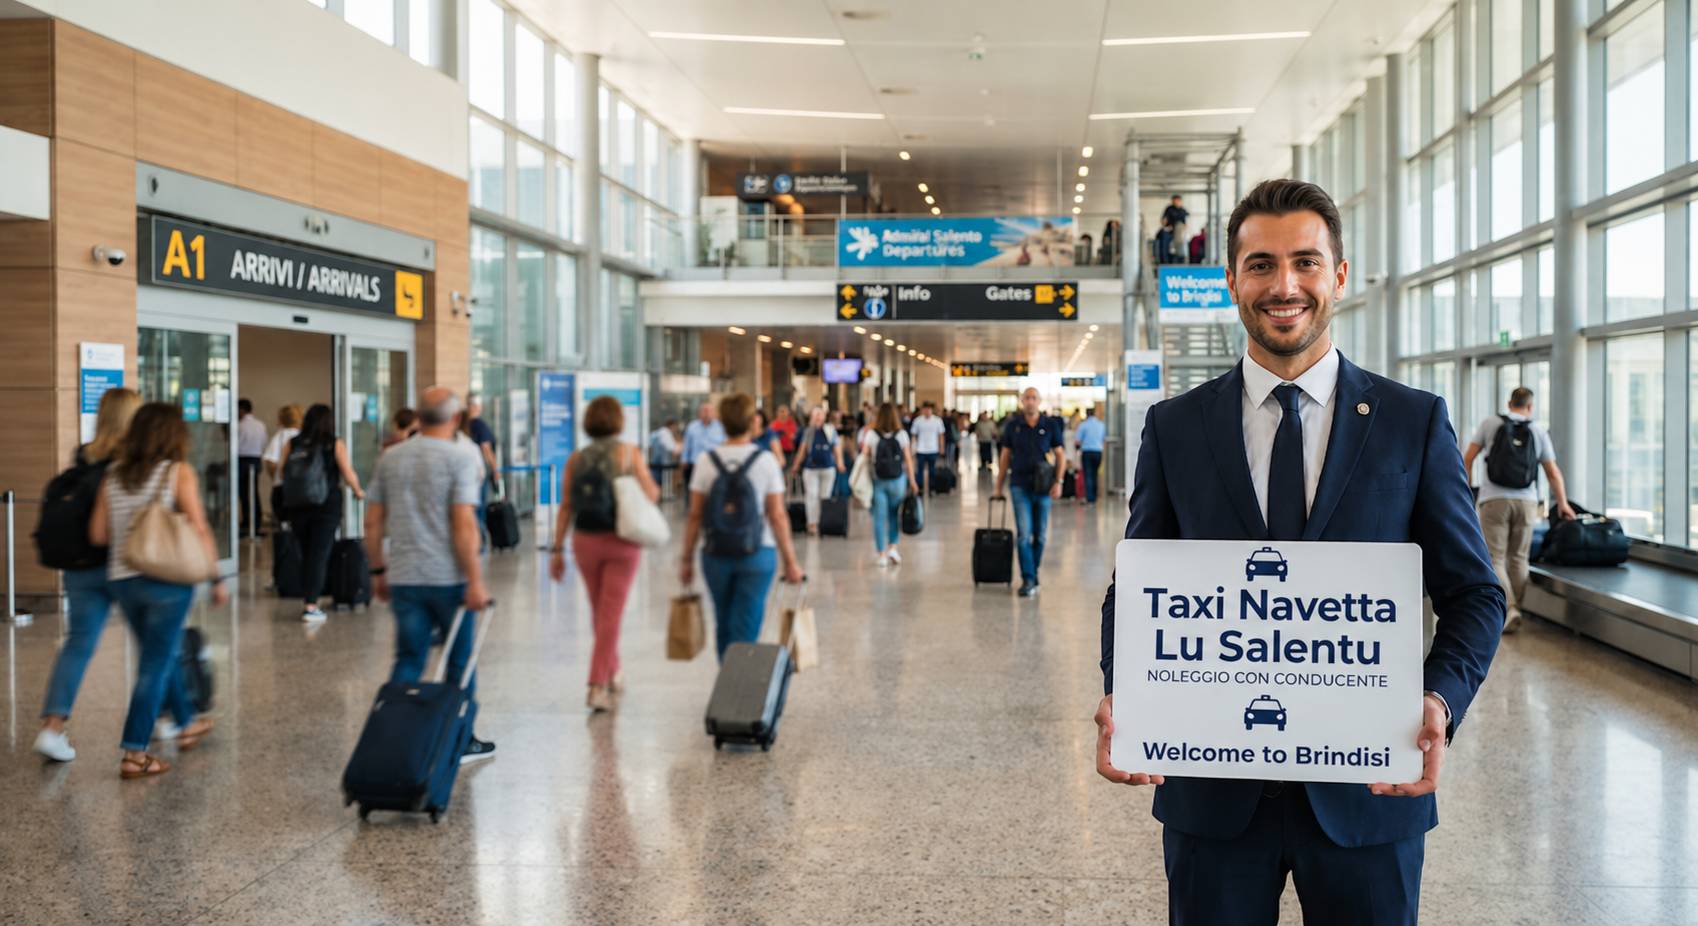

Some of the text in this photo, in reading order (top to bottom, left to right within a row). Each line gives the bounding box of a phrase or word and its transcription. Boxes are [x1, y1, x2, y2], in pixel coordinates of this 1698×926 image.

[882, 244, 966, 260] Departures
[163, 231, 205, 280] A1
[230, 249, 294, 288] ARRIVI
[308, 265, 381, 303] ARRIVALS
[898, 285, 931, 301] Info
[985, 285, 1032, 301] Gates
[1166, 291, 1180, 304] to
[1143, 586, 1397, 623] Taxi Navetta
[1155, 629, 1381, 666] Lu Salentu
[1147, 669, 1388, 688] NOLEGGIO CON CONDUCENTE
[1143, 742, 1391, 768] Welcome to Brindisi
